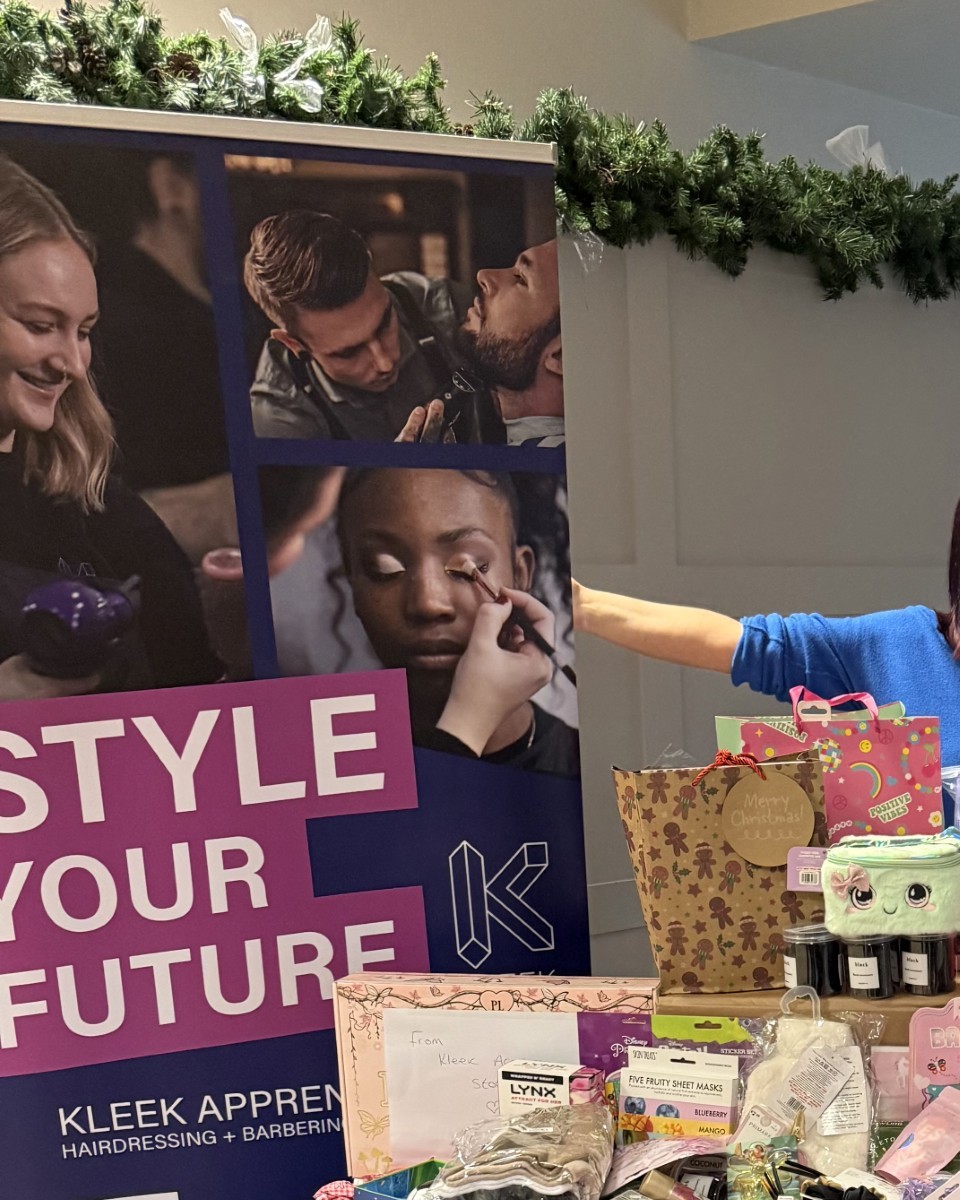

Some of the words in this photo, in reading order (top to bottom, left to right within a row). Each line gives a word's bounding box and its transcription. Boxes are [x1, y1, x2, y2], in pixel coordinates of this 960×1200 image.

[0, 693, 386, 834] STYLE
[744, 793, 790, 812] Merry
[870, 793, 912, 817] POSITIVE
[731, 807, 804, 826] Christmas!
[880, 805, 908, 822] VIBES
[0, 836, 269, 943] YOUR
[0, 919, 395, 1050] FUTURE
[410, 1030, 444, 1048] From
[622, 1036, 648, 1046] Disney
[510, 1083, 556, 1099] LYNX
[628, 1075, 644, 1084] FIVE
[646, 1077, 671, 1087] FRUITY
[672, 1079, 695, 1089] SHEET
[696, 1082, 723, 1092] MASKS
[58, 1097, 187, 1137] KLEEK
[694, 1108, 728, 1119] BLUEBERRY
[62, 1131, 217, 1160] HAIRDRESSING
[243, 1117, 345, 1142] BARBERIN
[698, 1126, 726, 1135] MANGO
[690, 1158, 723, 1169] COCONUT
